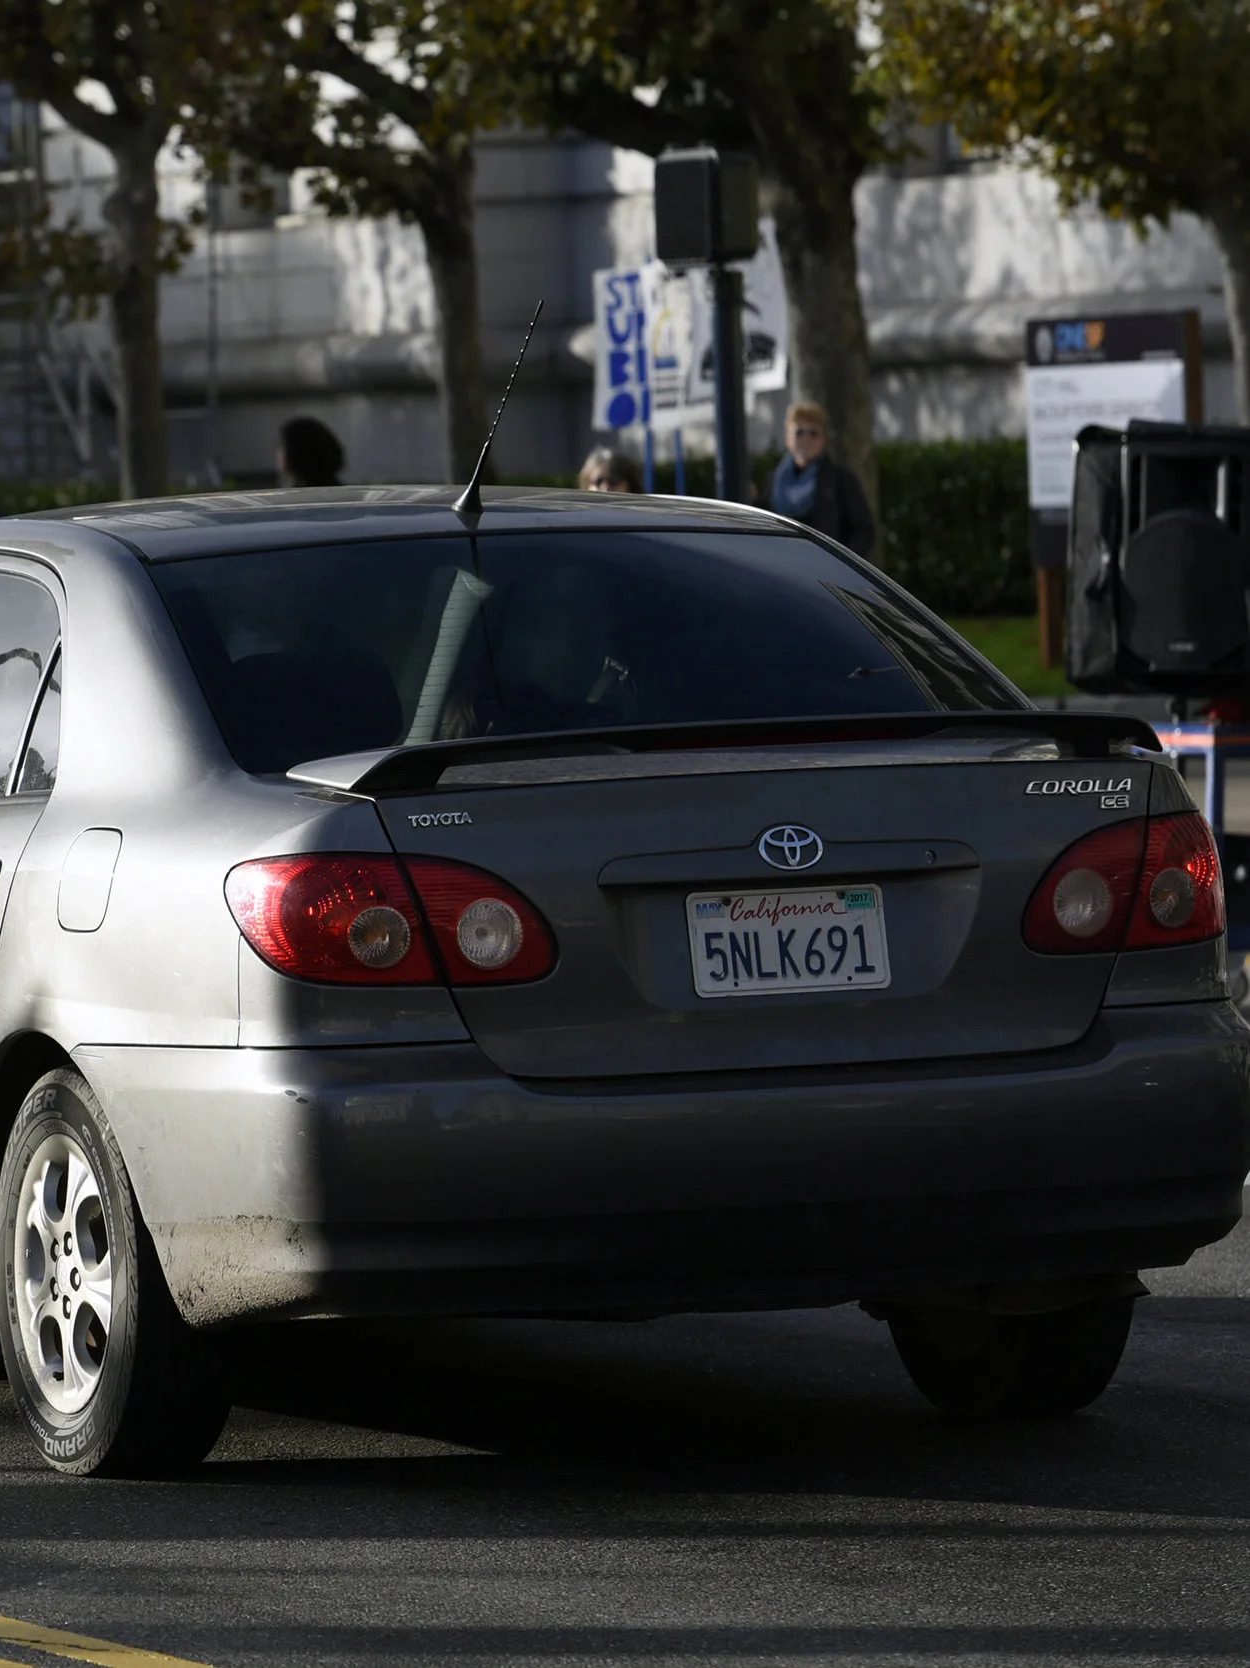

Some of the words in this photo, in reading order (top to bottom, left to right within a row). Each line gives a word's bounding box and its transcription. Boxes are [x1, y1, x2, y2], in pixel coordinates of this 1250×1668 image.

[1025, 778, 1132, 795] COROLLA
[1100, 794, 1130, 809] CE
[407, 811, 473, 828] TOYOTA
[849, 893, 869, 903] 2017
[730, 895, 848, 926] California
[704, 924, 875, 982] 5NLK691
[44, 1415, 96, 1457] GRAND
